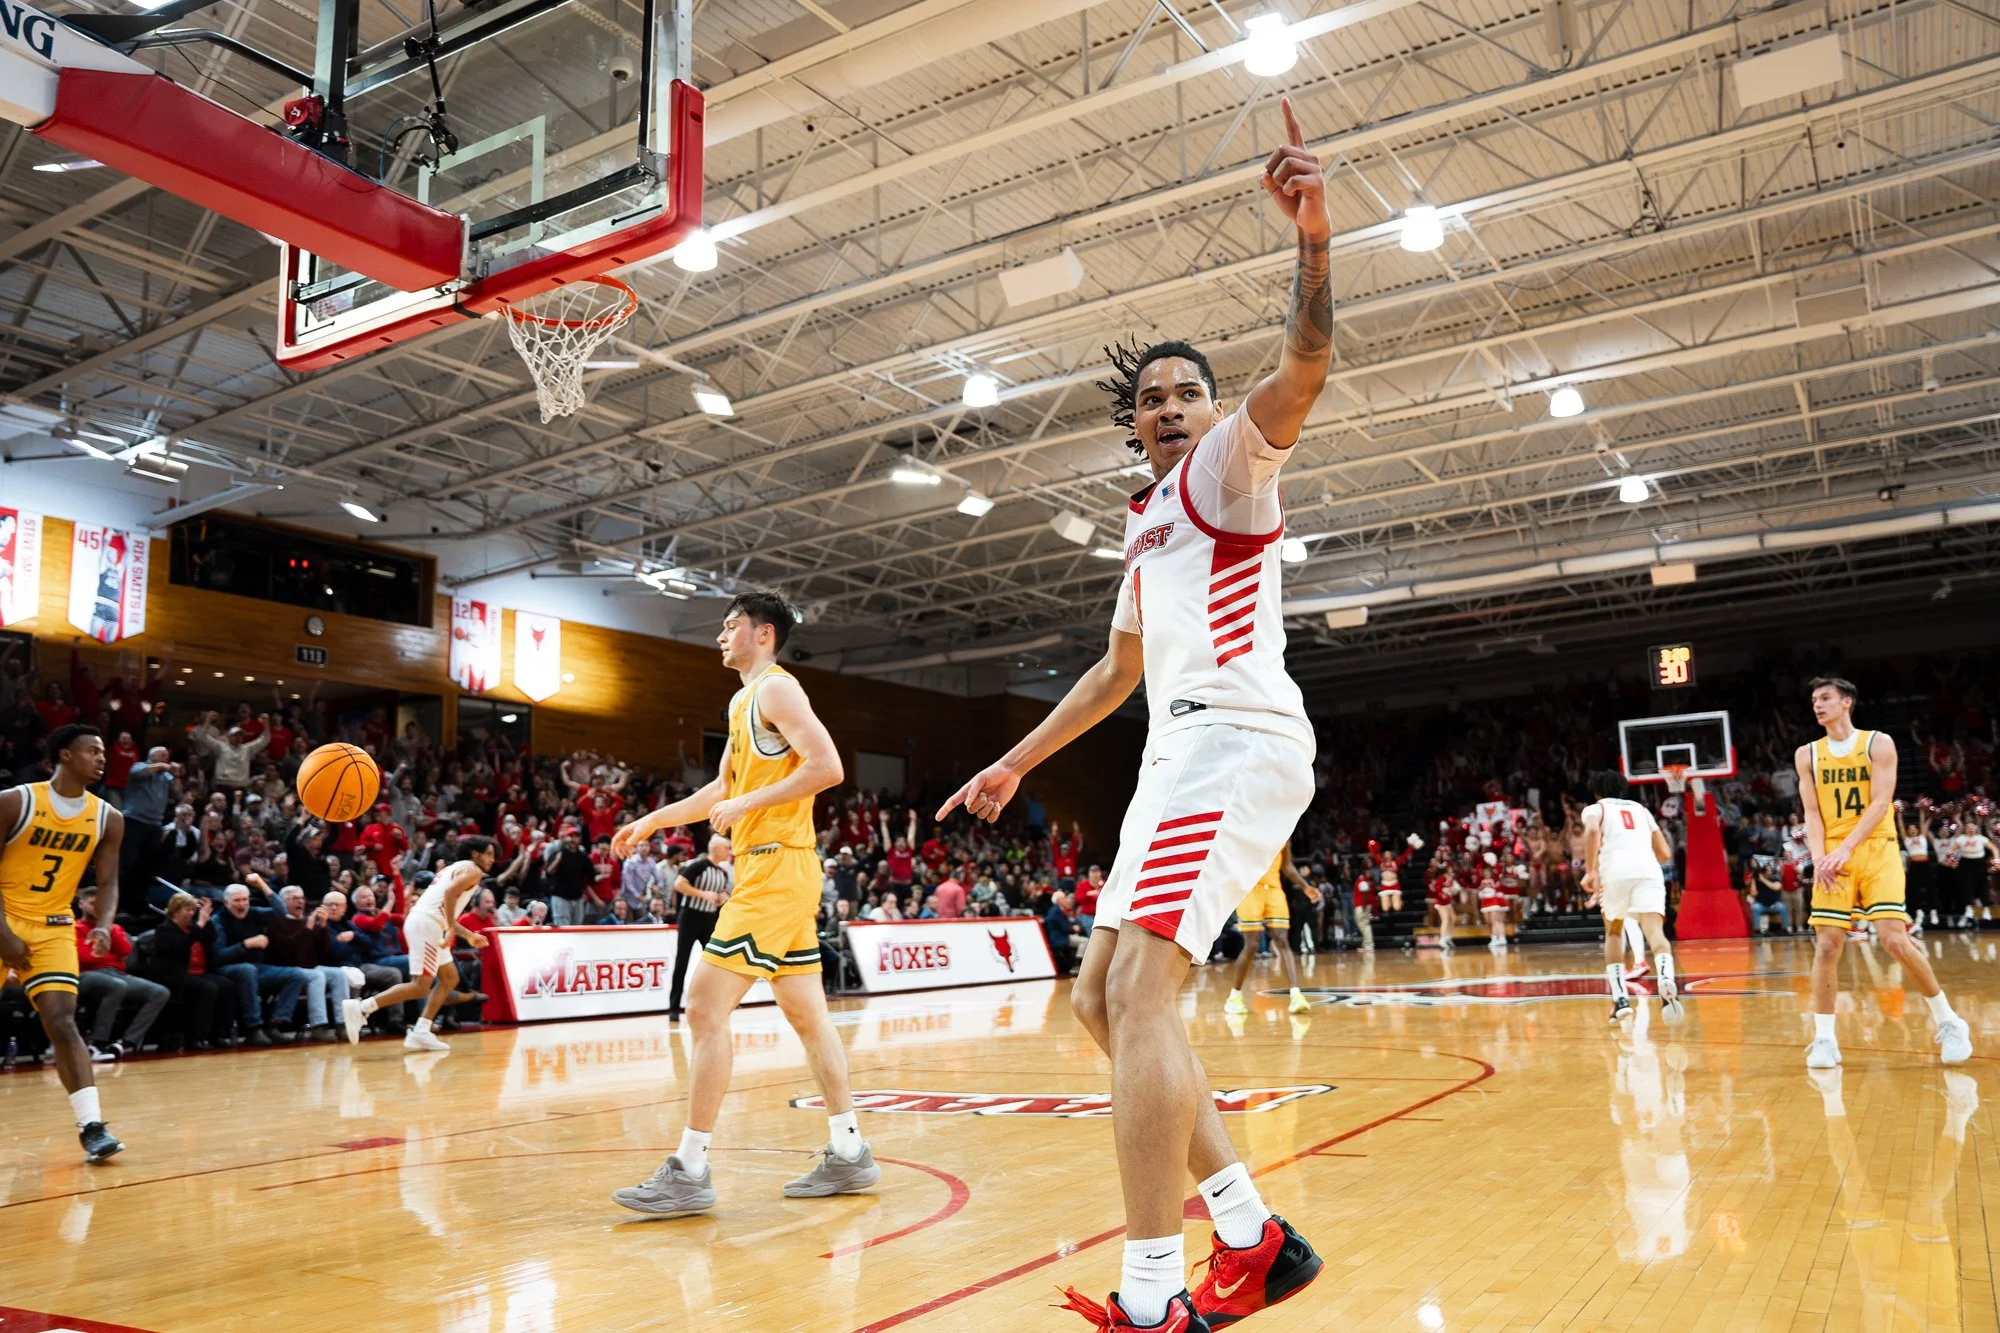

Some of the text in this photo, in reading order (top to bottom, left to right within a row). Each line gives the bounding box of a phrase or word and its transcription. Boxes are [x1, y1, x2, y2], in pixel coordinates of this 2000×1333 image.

[78, 529, 100, 550] 45
[132, 539, 145, 564] RIK
[129, 566, 144, 610] SMITS
[1659, 661, 1688, 685] 30
[1822, 765, 1872, 785] SIENA
[1834, 786, 1866, 818] 14
[1619, 809, 1636, 830] 0
[28, 825, 93, 853] SIENA
[30, 853, 64, 893] 3
[878, 940, 950, 974] FOXES
[522, 948, 668, 998] MARIST
